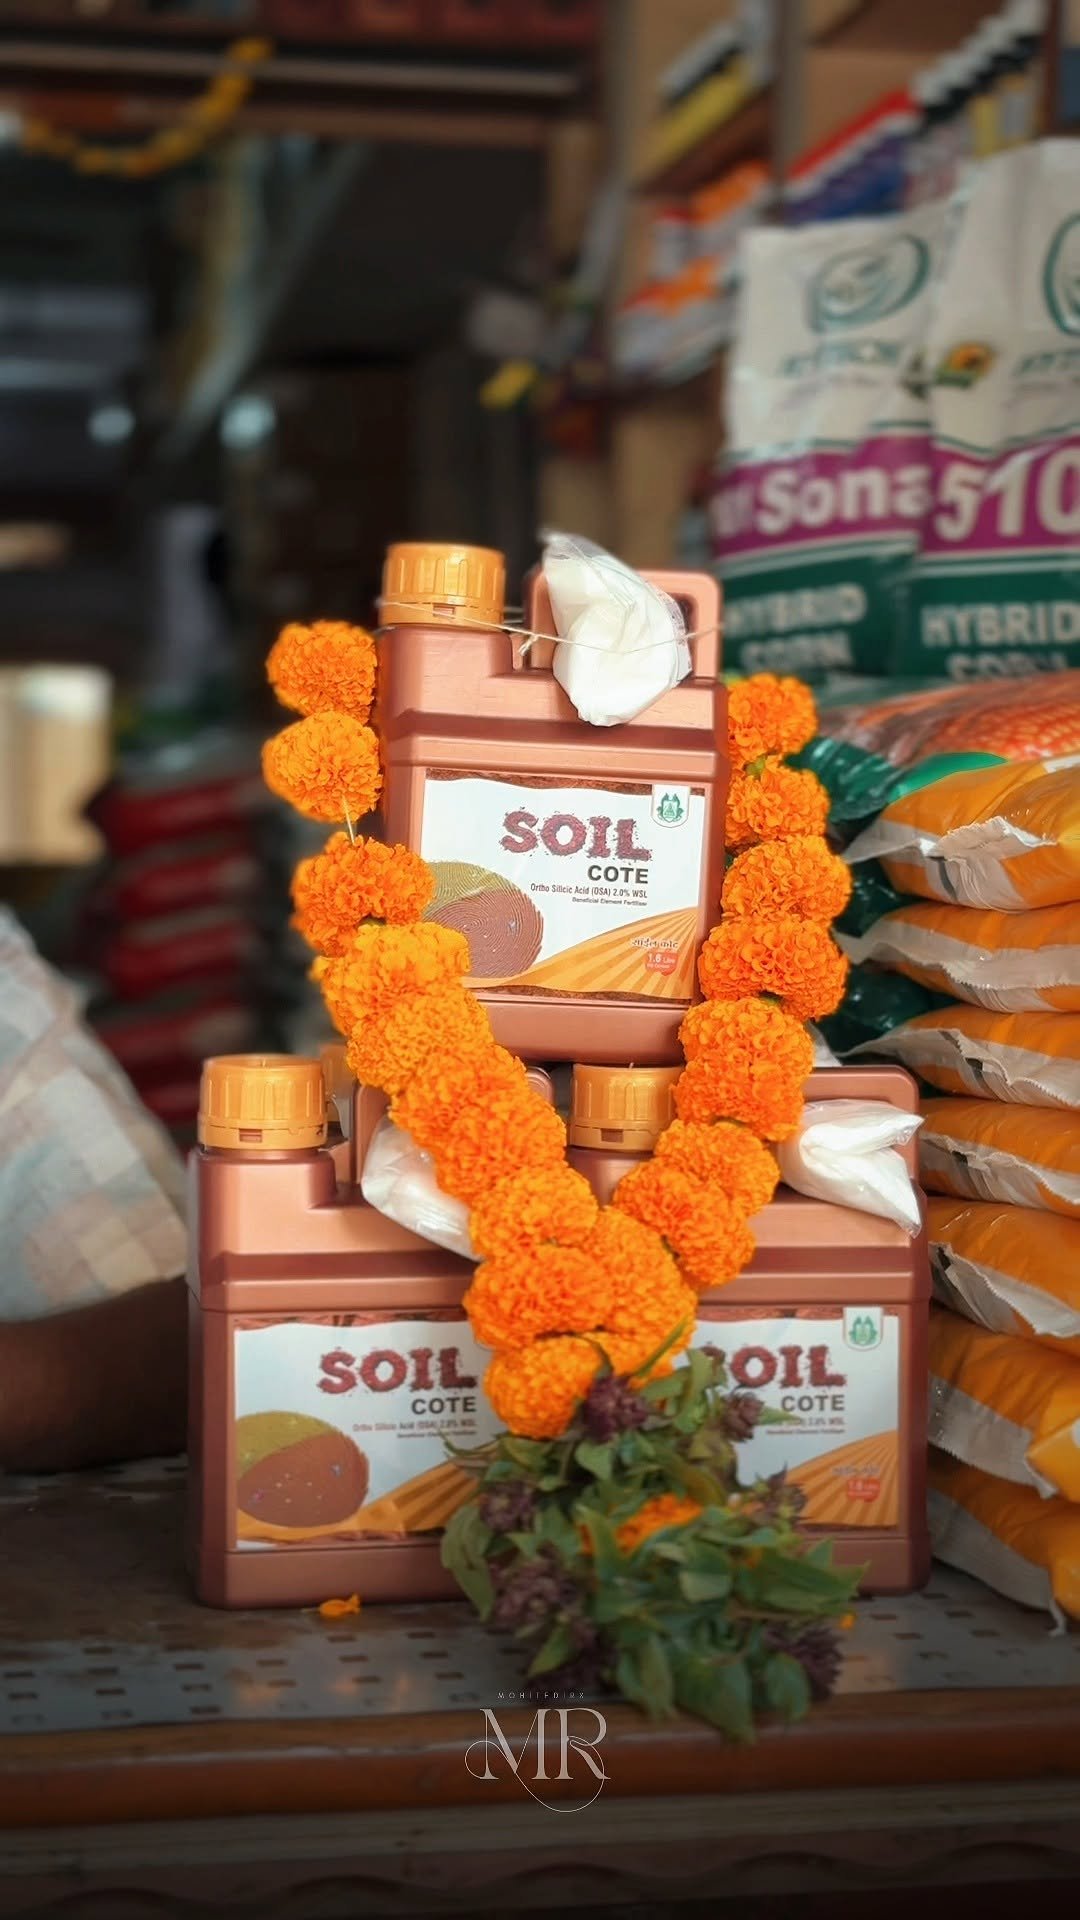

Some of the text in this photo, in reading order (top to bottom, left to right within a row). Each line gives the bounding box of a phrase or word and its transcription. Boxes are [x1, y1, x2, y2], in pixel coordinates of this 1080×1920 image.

[921, 601, 1080, 648] HYBRID
[500, 808, 652, 862] SOIL
[587, 865, 648, 884] COTE
[530, 883, 550, 893] Ortho
[574, 885, 590, 895] Acid
[591, 887, 611, 897] (OSA)
[612, 888, 631, 898] 2.0%
[632, 889, 648, 899] WSL
[317, 1346, 478, 1396] SOIL
[411, 1396, 477, 1415] COTE
[781, 1394, 845, 1412] COTE
